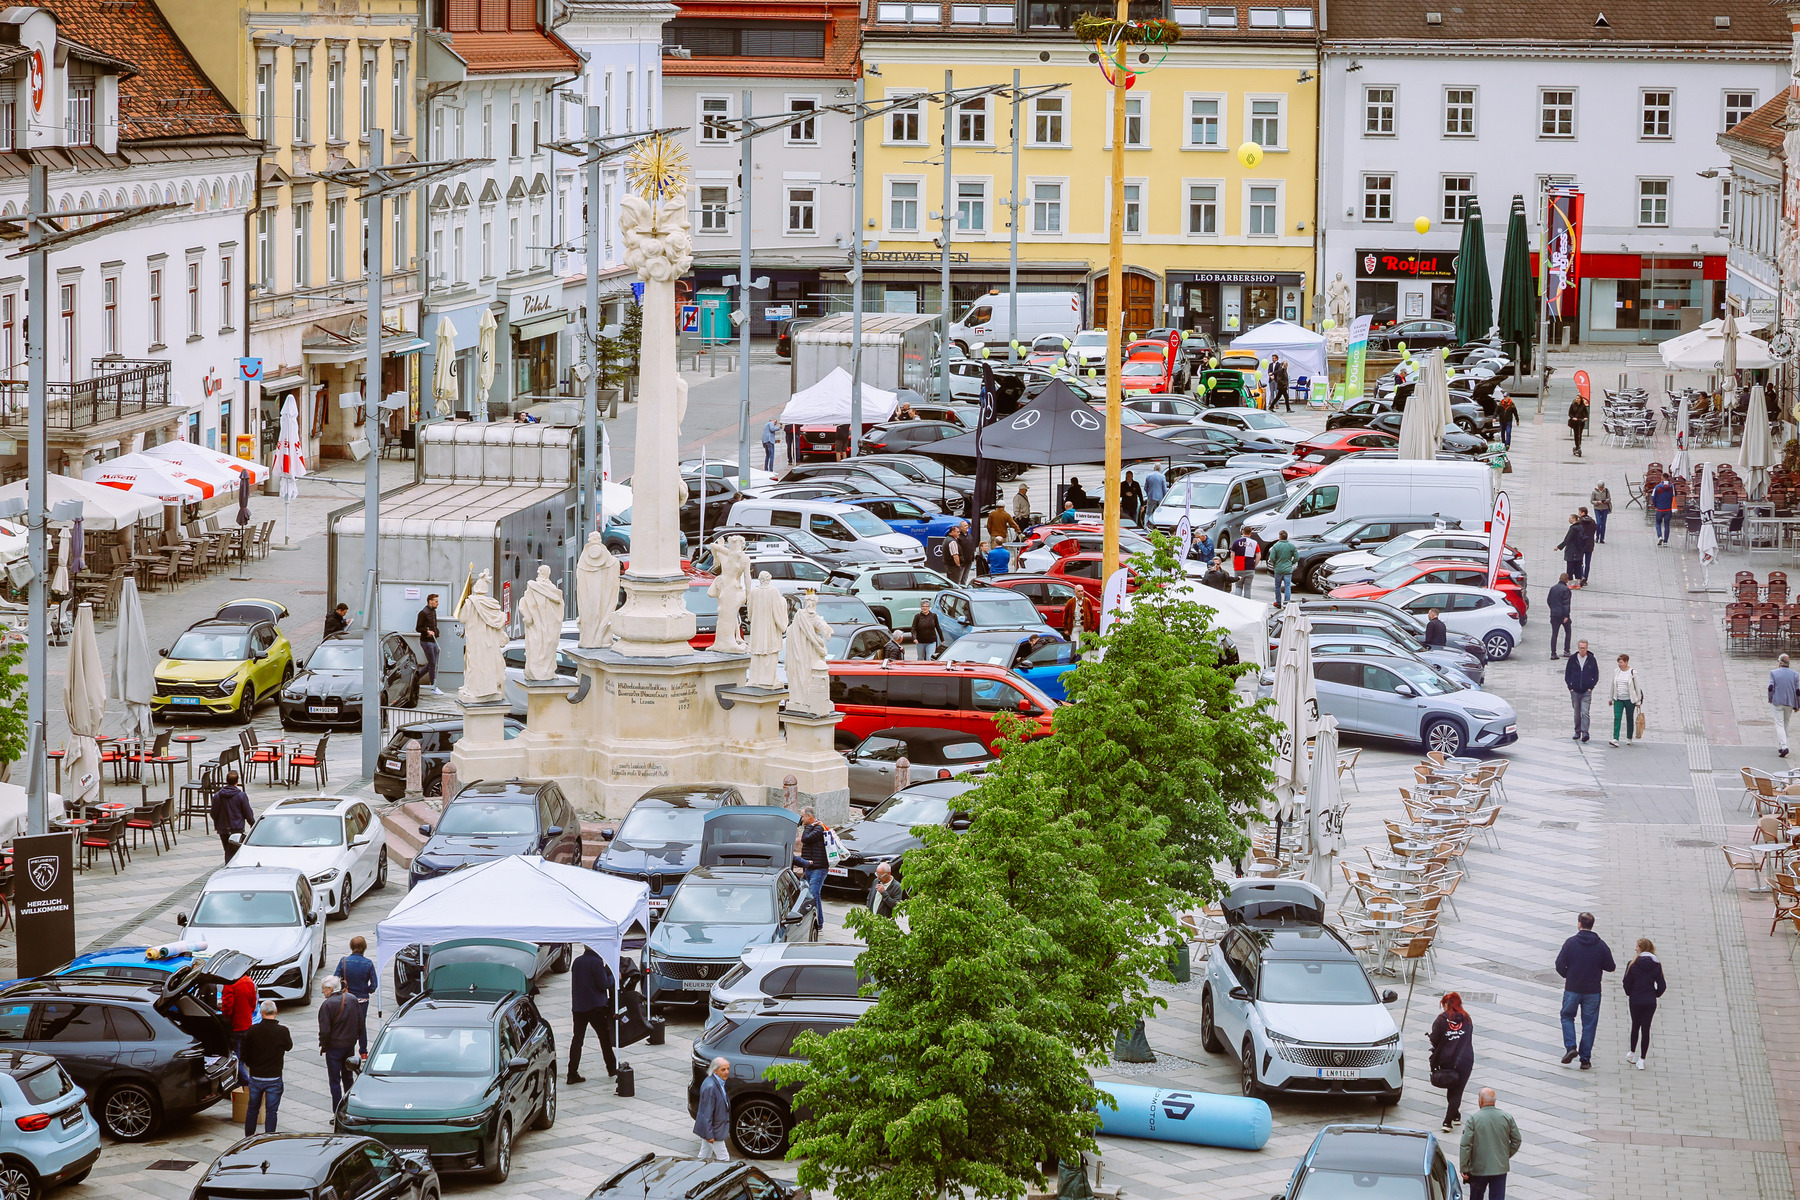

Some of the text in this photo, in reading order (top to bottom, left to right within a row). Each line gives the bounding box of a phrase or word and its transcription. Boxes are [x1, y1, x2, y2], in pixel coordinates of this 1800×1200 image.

[1382, 256, 1437, 274] Royal
[27, 899, 62, 908] HERZLICH
[21, 905, 69, 915] WILLKOMMEN
[1327, 1068, 1335, 1077] LN
